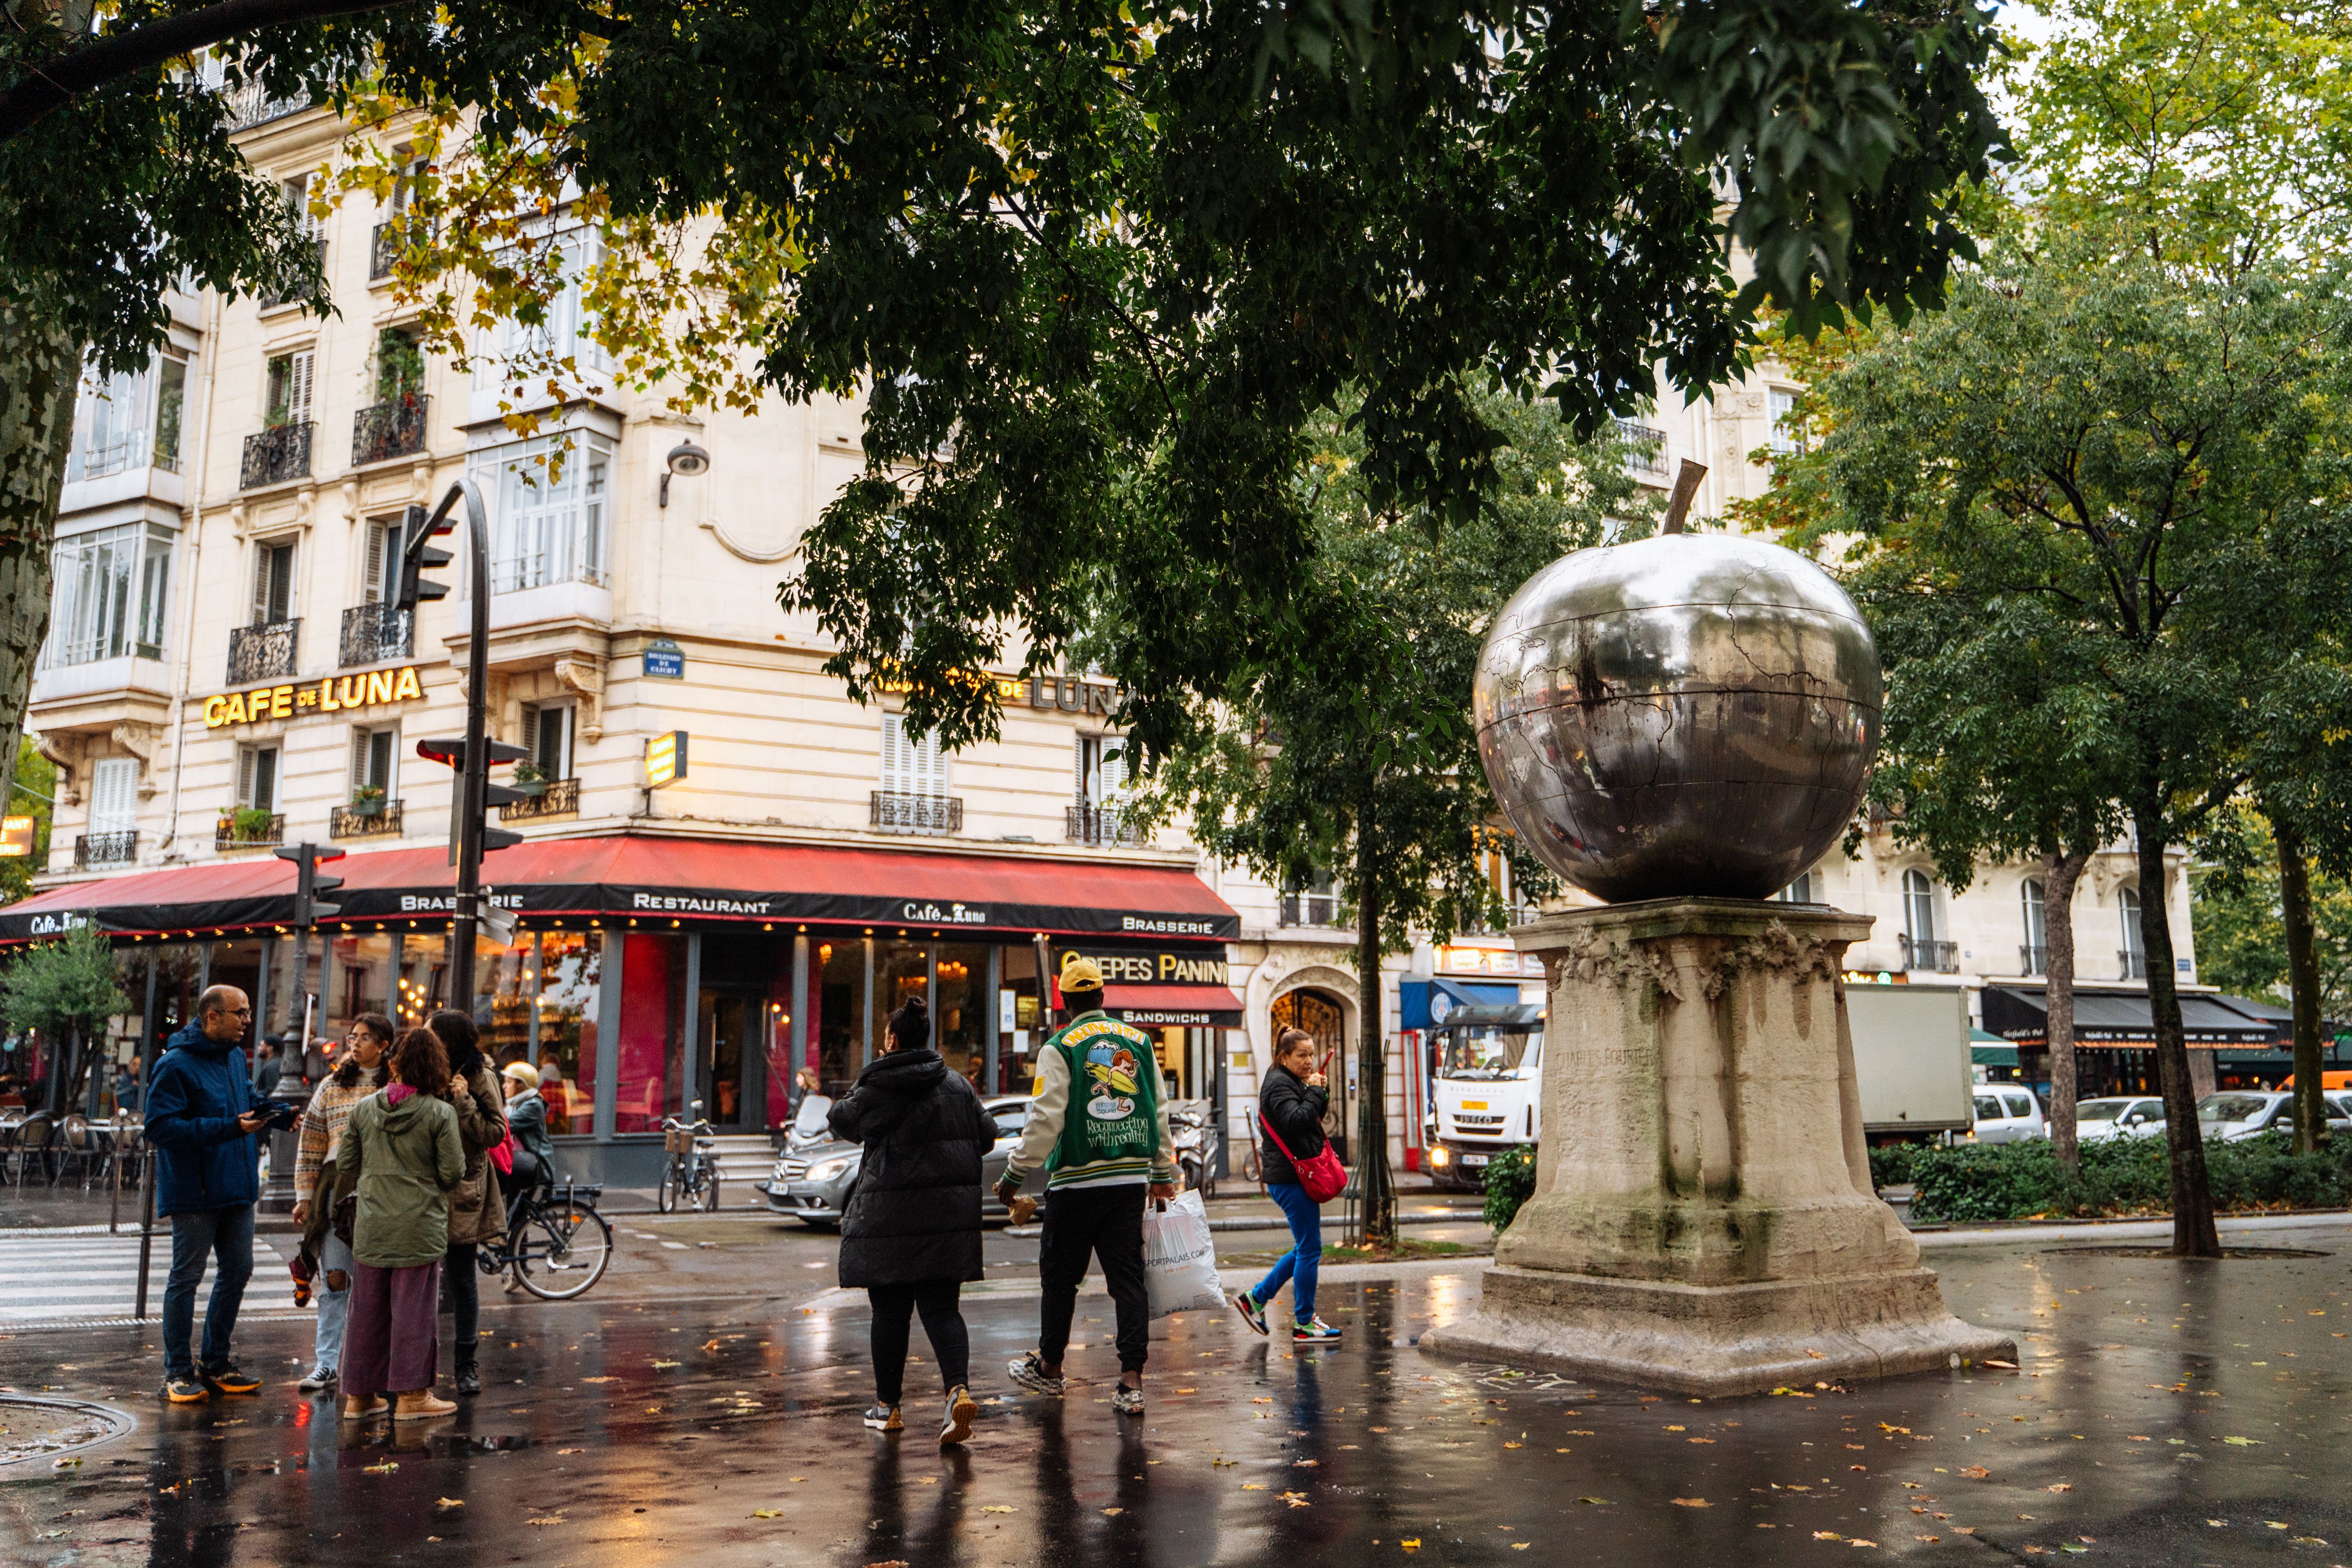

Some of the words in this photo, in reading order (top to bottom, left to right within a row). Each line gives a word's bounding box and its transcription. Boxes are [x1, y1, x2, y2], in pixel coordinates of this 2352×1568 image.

[647, 653, 681, 662] BOULEVARD
[204, 685, 294, 727] CAFE
[297, 689, 316, 707] DE
[320, 666, 421, 711] LUNA
[1000, 681, 1024, 698] DE
[401, 895, 524, 911] BRASRIE
[633, 893, 771, 914] RESTAURANT
[903, 903, 941, 921] Café
[952, 903, 986, 923] Luna
[1122, 916, 1213, 934] BRASSERIE
[1159, 954, 1228, 985] PANINI
[1123, 1011, 1209, 1023] SANDWICHS
[1062, 1021, 1111, 1046] ONGOING
[1604, 1048, 1653, 1067] FOURIER
[1087, 1117, 1148, 1134] Reconnecting
[1088, 1131, 1113, 1147] with
[1115, 1129, 1148, 1147] reality
